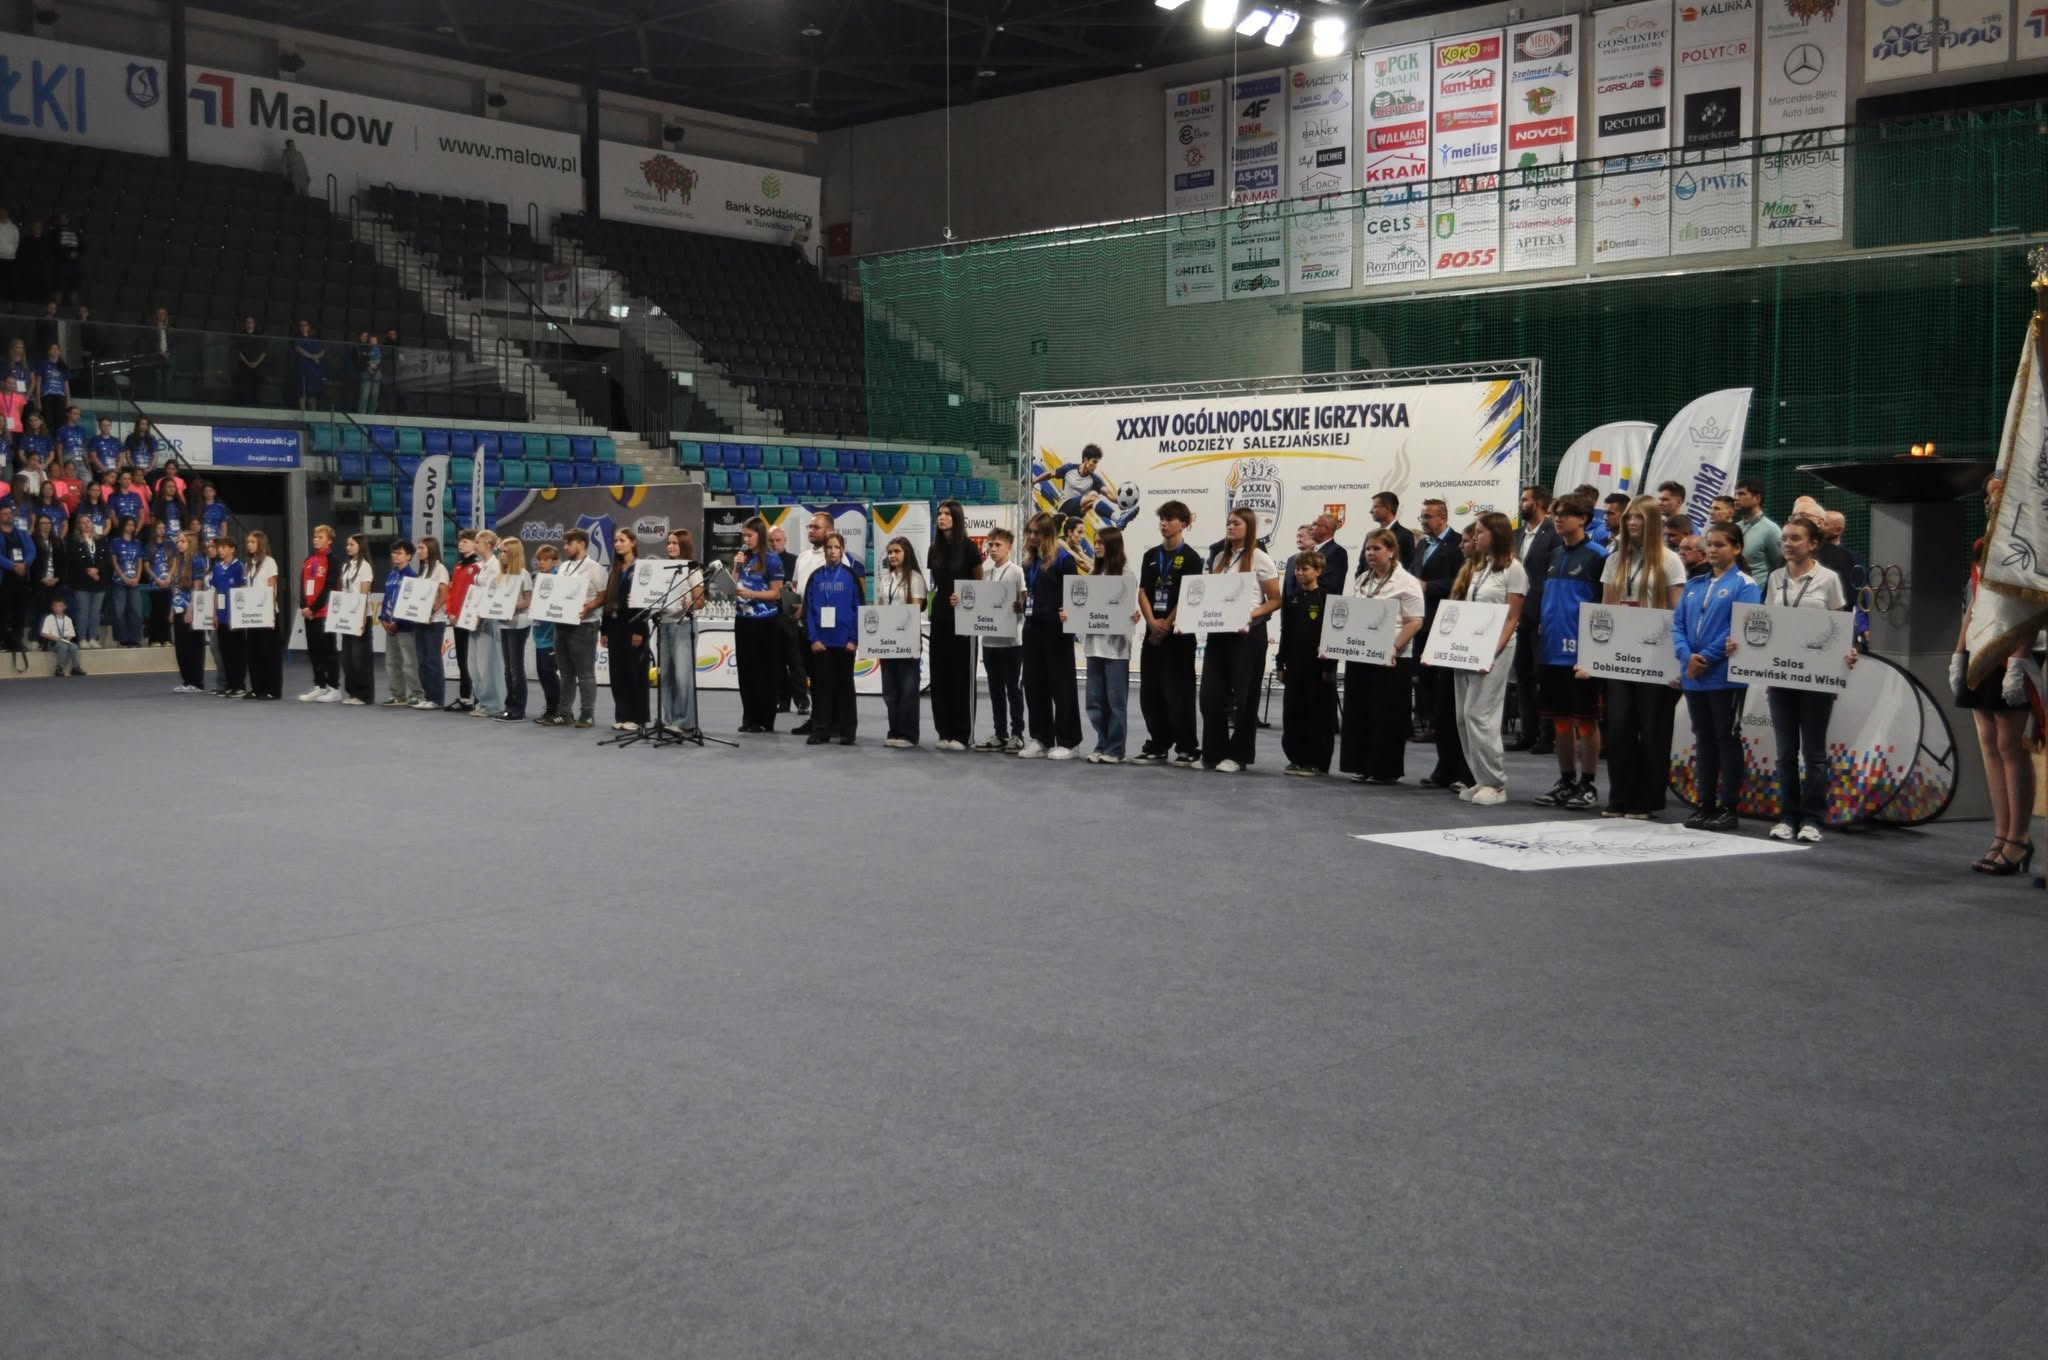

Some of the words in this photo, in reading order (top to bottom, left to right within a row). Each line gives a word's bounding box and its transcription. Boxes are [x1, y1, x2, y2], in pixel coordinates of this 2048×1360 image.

[1701, 0, 1752, 16] KALINKA
[1441, 44, 1479, 63] KOKO
[1388, 53, 1419, 72] PGK
[1512, 66, 1552, 79] Szelment
[1597, 80, 1645, 94] CARSLAB
[1768, 89, 1838, 107] Mercedes-Benz
[1242, 99, 1270, 118] 4F
[1781, 107, 1803, 118] Auto
[1805, 105, 1824, 116] Idea
[250, 87, 393, 147] Malow
[1377, 128, 1424, 144] WALMAR
[1516, 126, 1568, 142] NOVOL
[1688, 130, 1736, 142] tracktec
[439, 135, 577, 174] www.malow.pl
[1318, 151, 1343, 163] KUCHNIE
[1451, 143, 1498, 159] melius
[1764, 150, 1840, 169] SERWISTAL
[1366, 163, 1425, 182] KRAM
[725, 200, 751, 214] Bank
[754, 204, 813, 224] Spółdzielczy
[754, 219, 795, 232] Suwałkach
[1516, 234, 1565, 249] APTEKA
[1436, 248, 1497, 269] BOSS
[1116, 414, 1169, 441] XXXIV
[1172, 406, 1310, 437] OGÓLNOPOLSKIE
[1314, 403, 1409, 429] IGRZYSKA
[157, 439, 183, 452] SIR
[1159, 435, 1234, 453] MŁODZIEŻY
[1243, 431, 1350, 450] SALEZJAŃSKIEJ
[1242, 484, 1271, 493] XXXIV
[1301, 483, 1337, 491] HONOROWY
[1420, 479, 1500, 488] WSPÓŁORGANIZATORZY
[1148, 488, 1180, 496] HONOROWY
[1236, 499, 1276, 508] IGRZYSKA
[1473, 504, 1494, 513] OSIR
[964, 516, 997, 529] SUWAŁKI
[1089, 612, 1109, 621] Salos
[1202, 610, 1222, 619] Salos
[1088, 620, 1110, 629] Lublin
[1198, 619, 1224, 628] Kraków
[1346, 636, 1366, 647] Salos
[1450, 642, 1469, 652] Salos
[896, 647, 912, 655] Zdrój
[1325, 645, 1360, 657] Jastrzębie
[1366, 648, 1385, 660] Zdrój
[1434, 652, 1449, 661] UKS
[1449, 653, 1467, 663] Salos
[1615, 652, 1642, 663] Salos
[1593, 661, 1664, 678] Dobieszczyzna
[1773, 657, 1804, 669] Salos
[1730, 665, 1787, 681] Czerwińsk
[1791, 673, 1811, 683] nad
[1815, 674, 1846, 688] Wisłą
